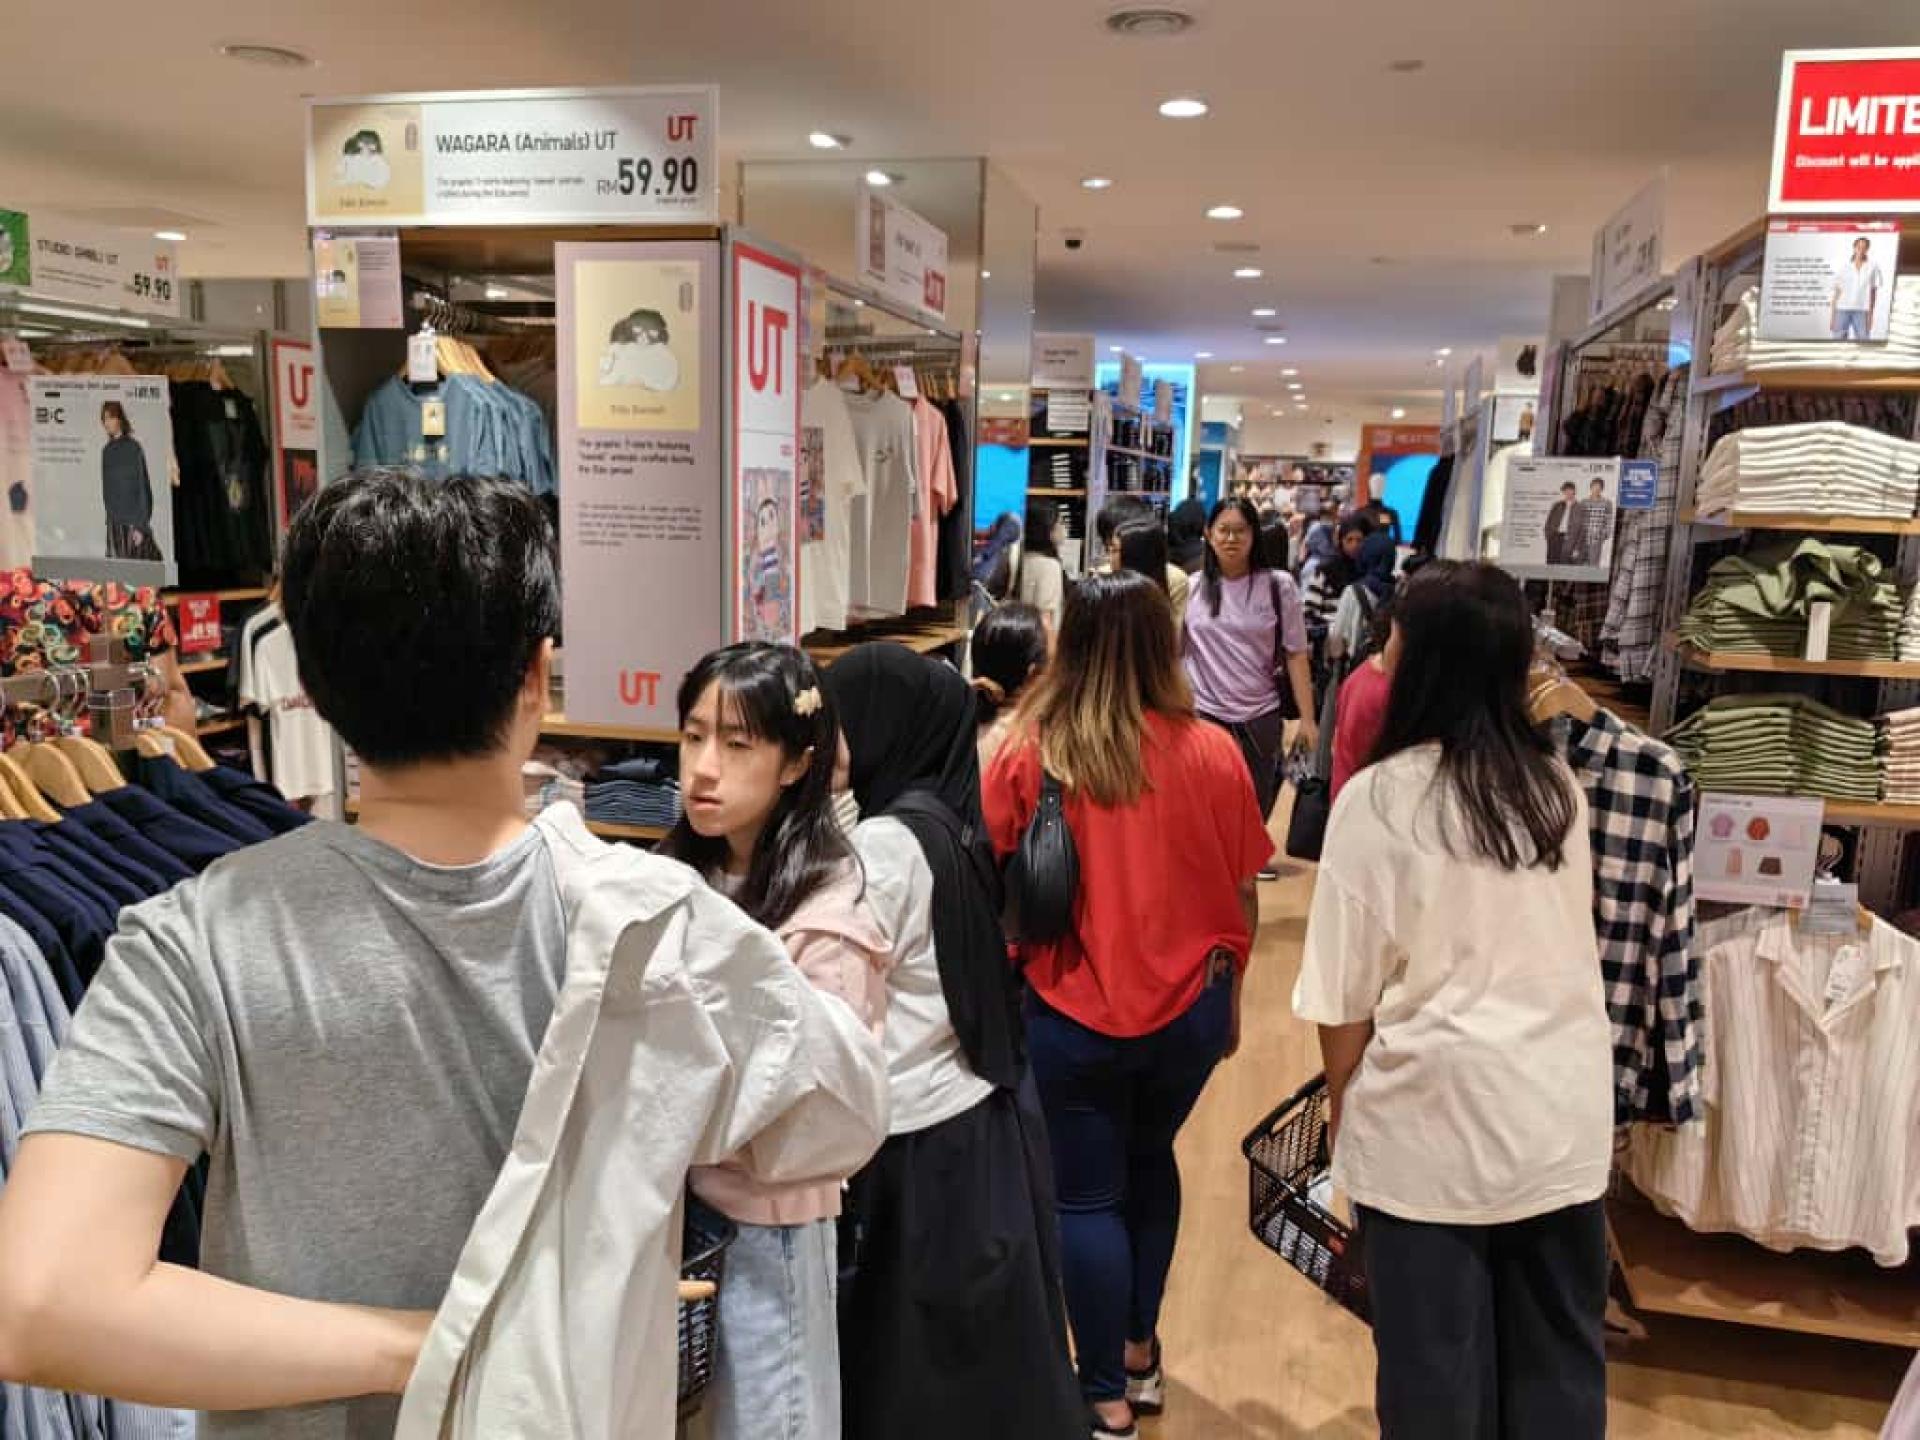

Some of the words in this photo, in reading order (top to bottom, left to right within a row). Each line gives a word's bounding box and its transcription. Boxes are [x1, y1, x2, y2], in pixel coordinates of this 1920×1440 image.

[668, 115, 698, 142] UT
[1799, 95, 1920, 136] LIMITE
[436, 134, 510, 153] WAGARA
[516, 132, 591, 151] (Animals)
[594, 131, 619, 150] UT
[748, 299, 789, 396] UT
[620, 668, 661, 706] UT
